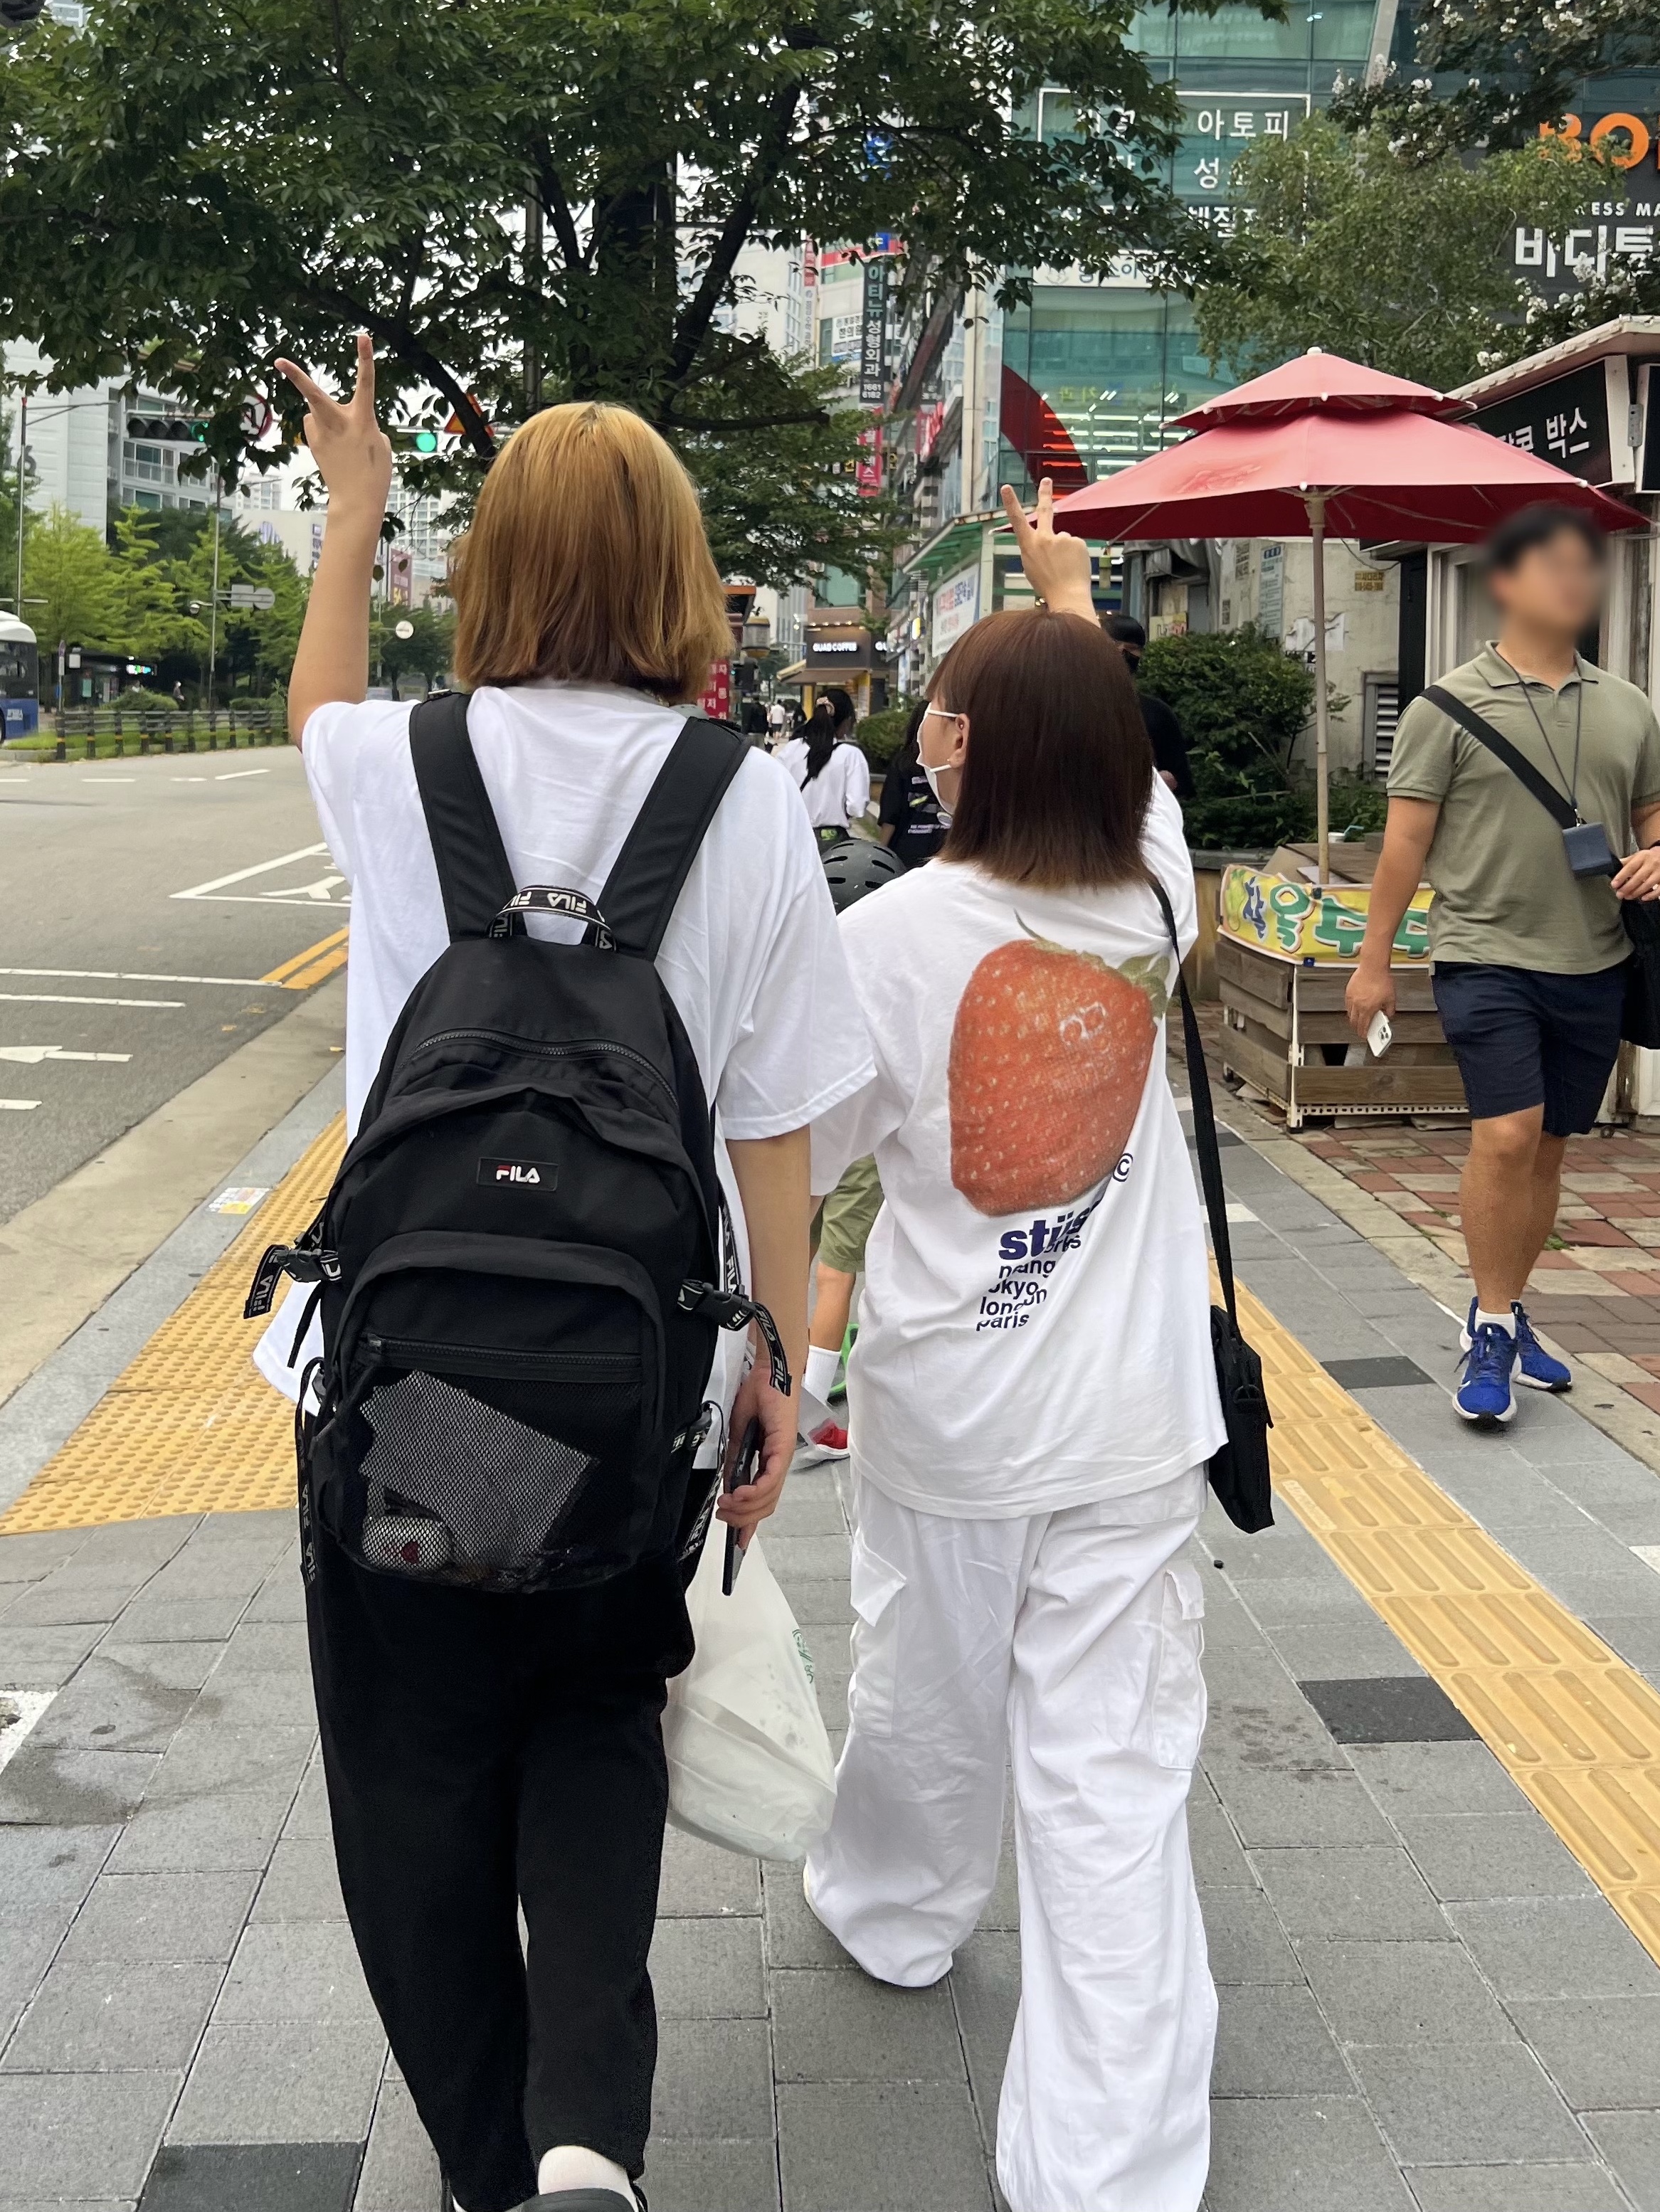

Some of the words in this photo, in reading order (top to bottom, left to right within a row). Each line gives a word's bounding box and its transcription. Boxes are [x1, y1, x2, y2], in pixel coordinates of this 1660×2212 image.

[1198, 109, 1289, 142] 아토피
[1545, 407, 1590, 459] 박스
[546, 892, 587, 914] FILA
[496, 1165, 541, 1184] FILA
